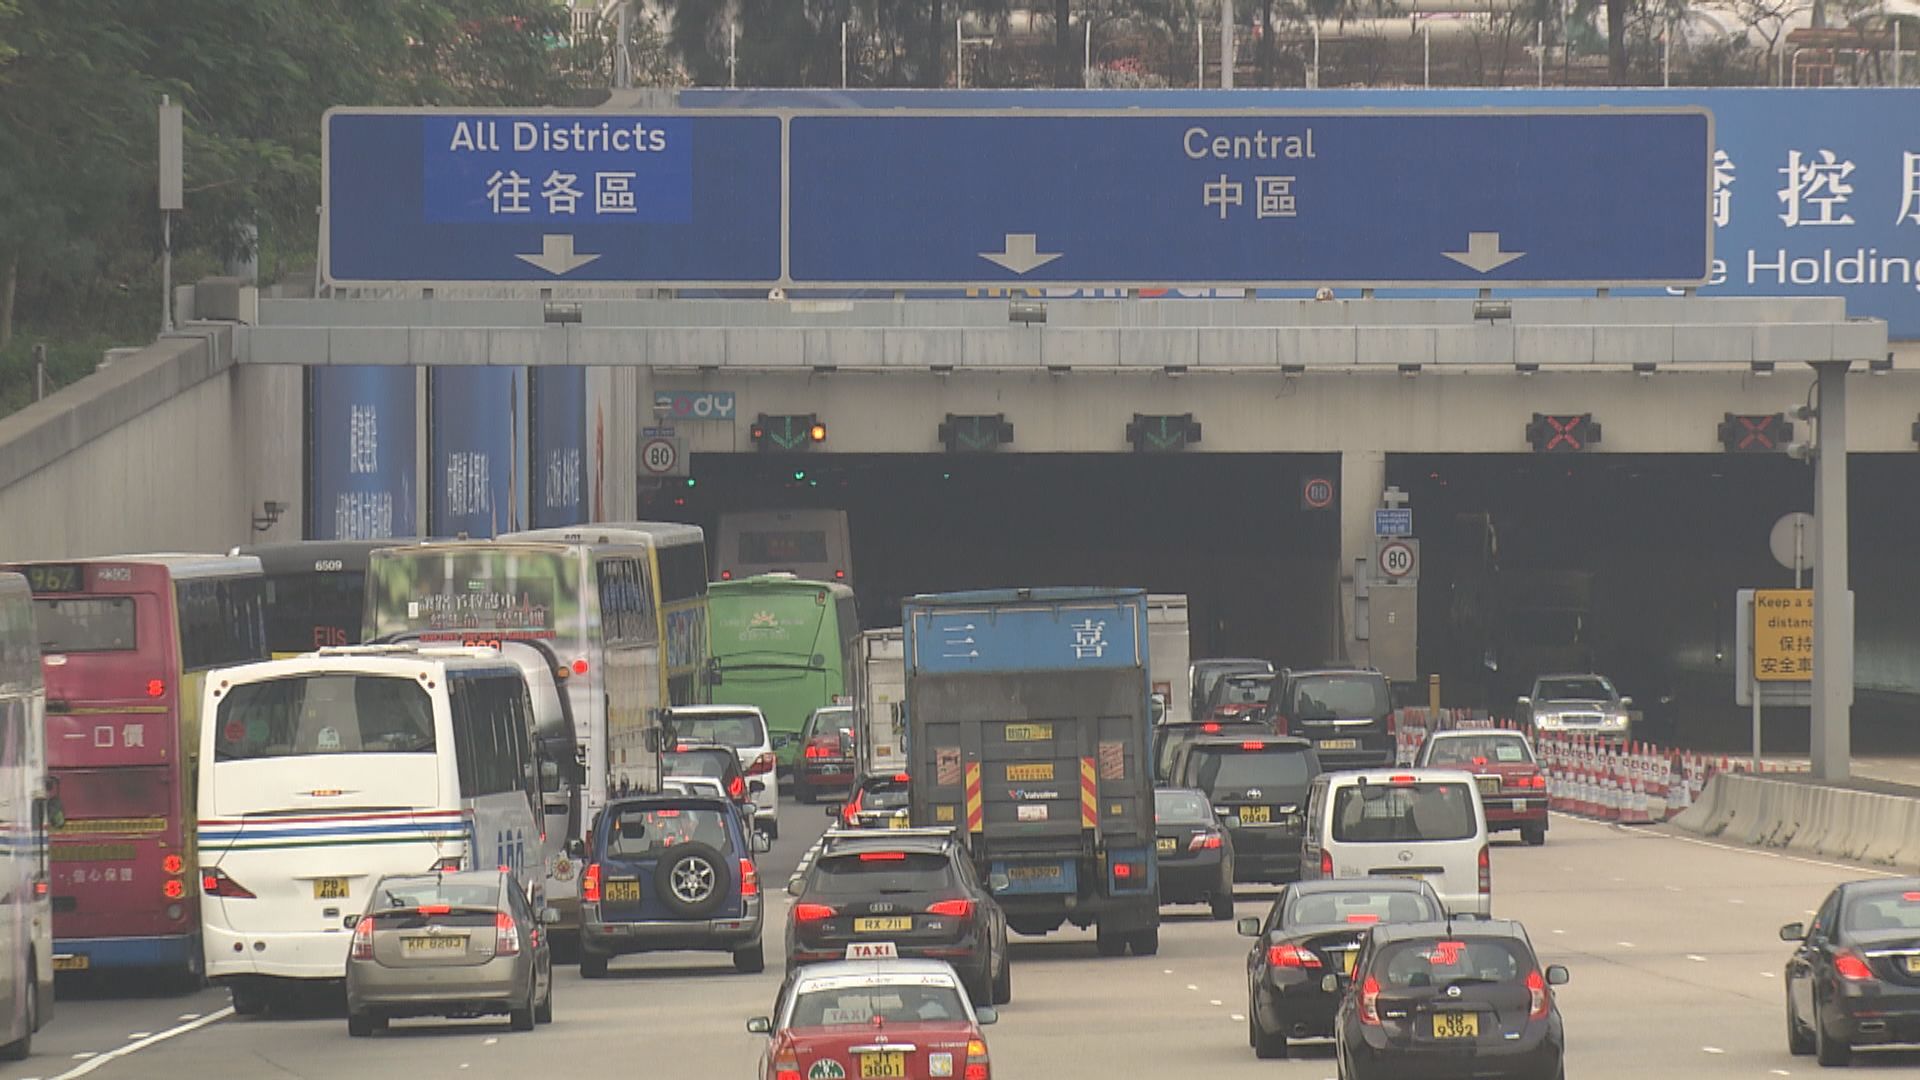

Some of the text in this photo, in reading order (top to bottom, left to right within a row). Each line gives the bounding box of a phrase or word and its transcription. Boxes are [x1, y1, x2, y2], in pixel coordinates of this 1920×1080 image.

[450, 121, 666, 151] All Districts
[1183, 126, 1316, 160] Central
[486, 169, 637, 214] 往各區
[1203, 174, 1297, 219] 中區
[651, 448, 669, 465] 80
[1389, 551, 1406, 569] 80
[1758, 596, 1791, 608] Keep
[1795, 599, 1802, 607] a
[864, 920, 881, 929] RX
[853, 946, 889, 956] TAXI
[1437, 1023, 1474, 1037] 9392
